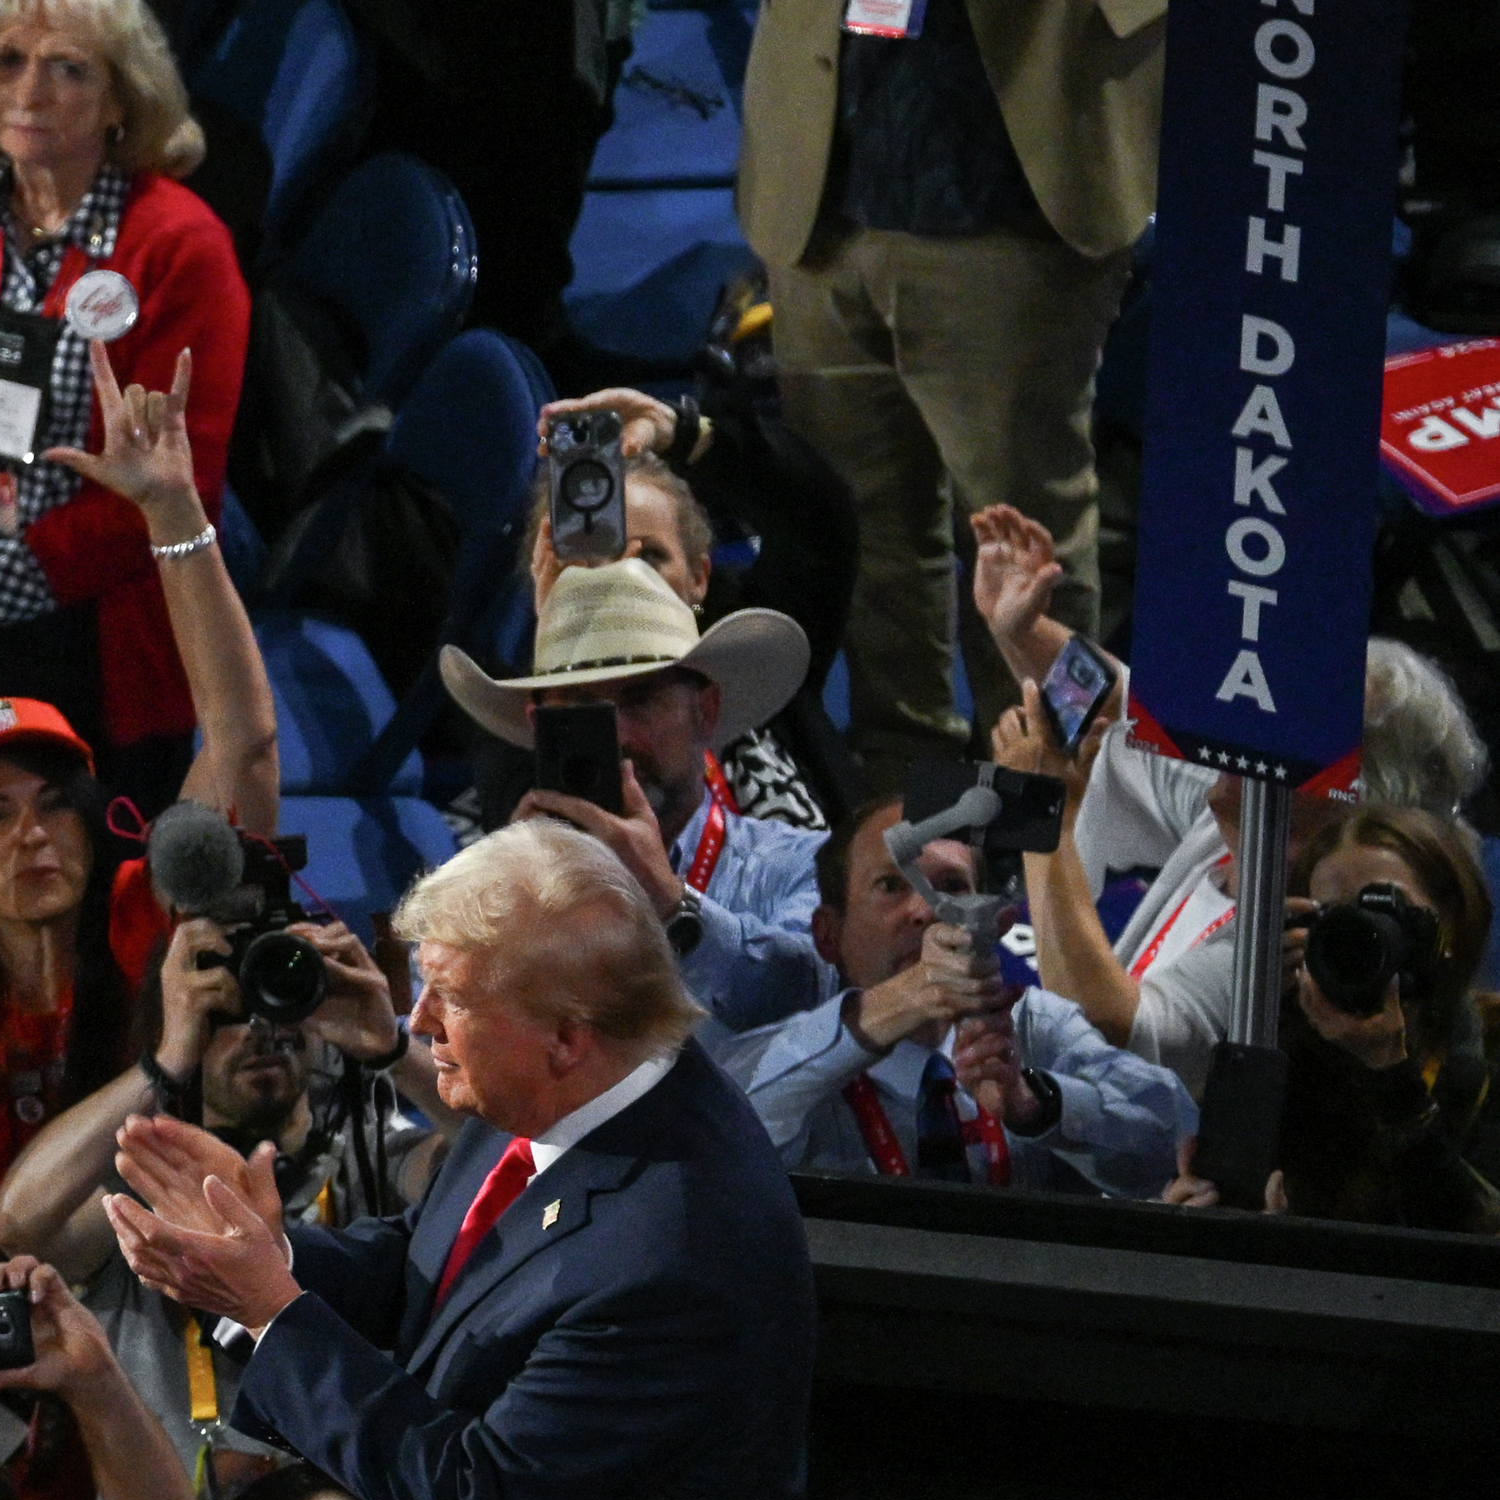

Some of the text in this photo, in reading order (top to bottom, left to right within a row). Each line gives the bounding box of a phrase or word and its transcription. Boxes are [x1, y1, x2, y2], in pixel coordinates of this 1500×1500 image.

[1214, 0, 1317, 716] ORTH DAKOTA
[1125, 732, 1160, 752] 2024
[1327, 785, 1358, 804] RNC
